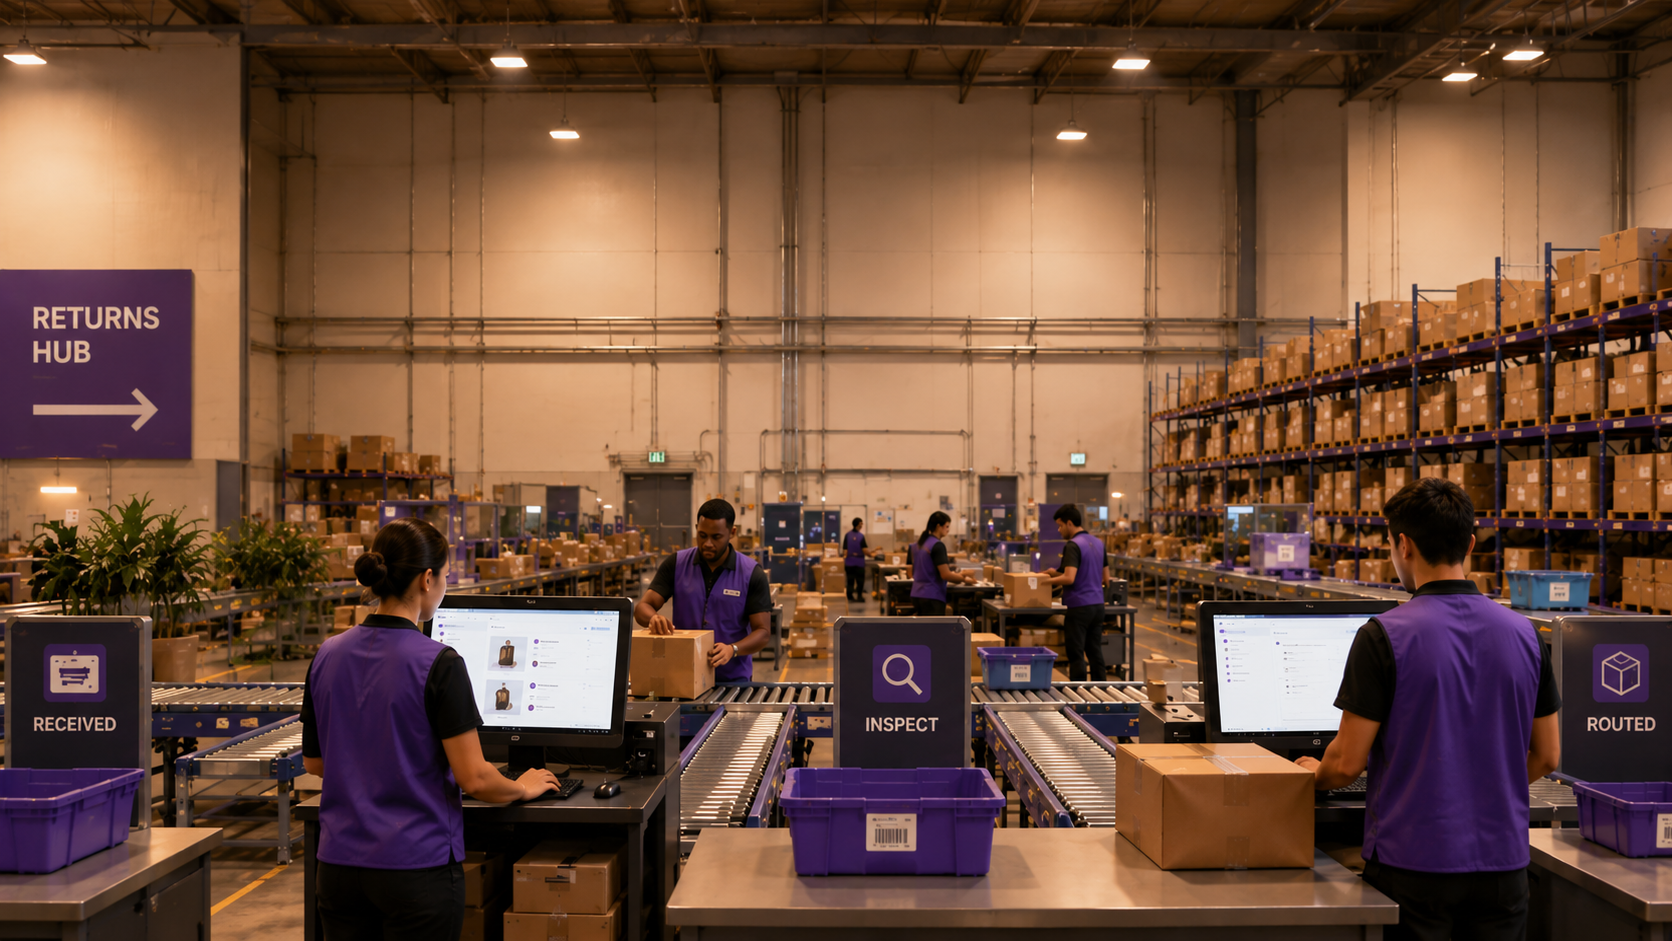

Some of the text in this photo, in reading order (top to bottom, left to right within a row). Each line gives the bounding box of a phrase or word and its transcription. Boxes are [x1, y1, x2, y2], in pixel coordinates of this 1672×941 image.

[33, 306, 160, 330] RETURNS
[33, 340, 91, 363] HUB
[33, 716, 117, 732] RECEIVED
[865, 717, 939, 732] INSPECT
[1586, 716, 1656, 732] ROUTED
